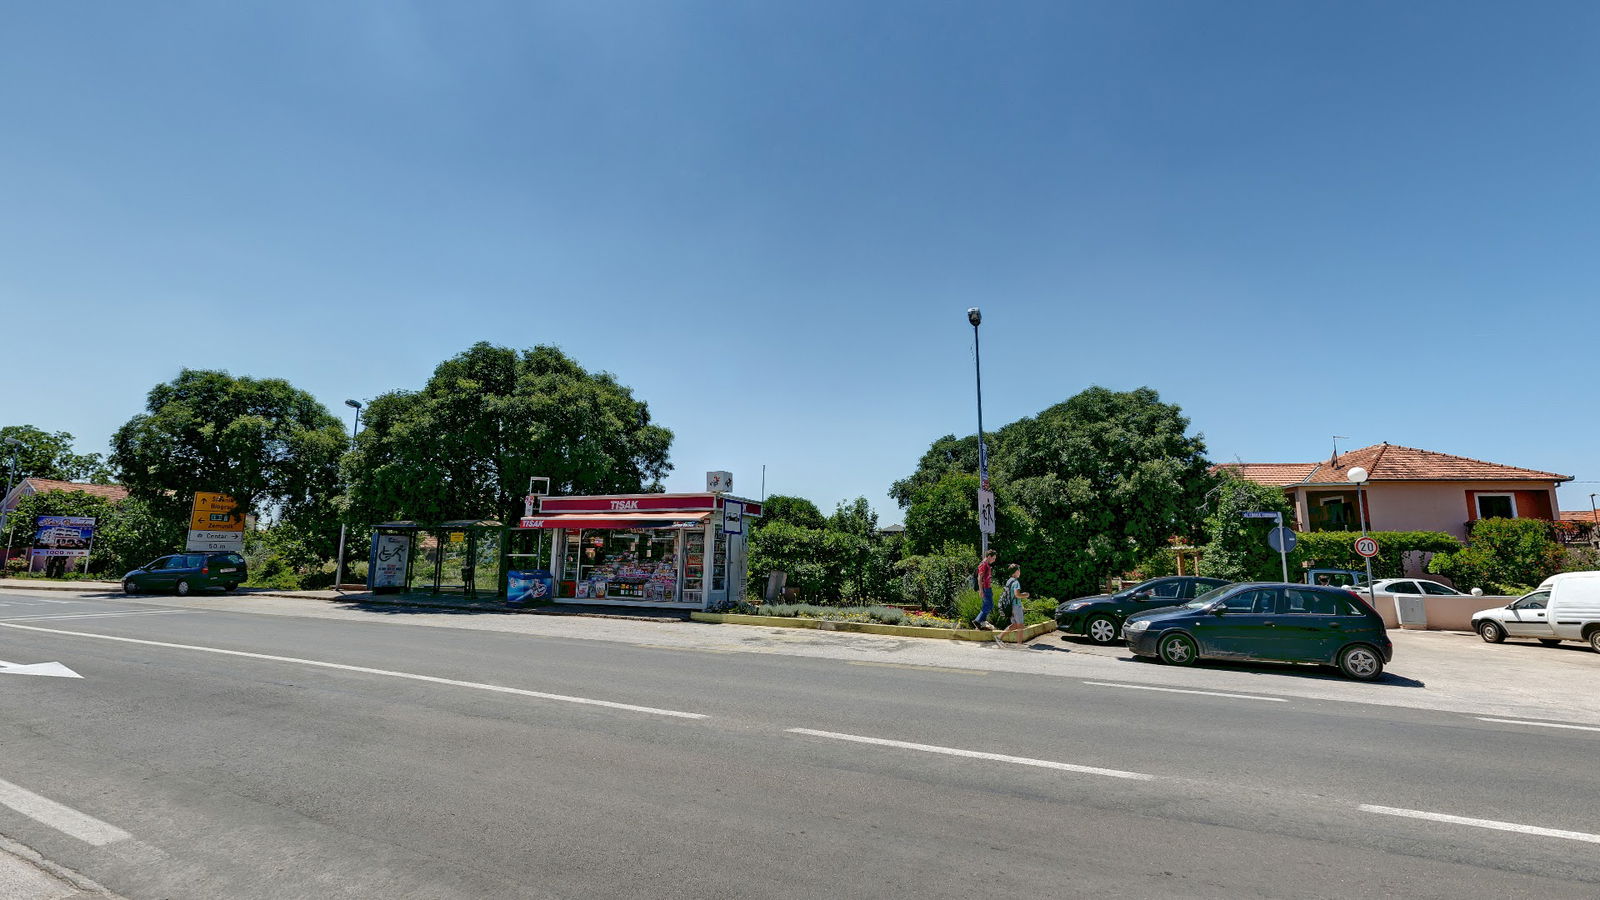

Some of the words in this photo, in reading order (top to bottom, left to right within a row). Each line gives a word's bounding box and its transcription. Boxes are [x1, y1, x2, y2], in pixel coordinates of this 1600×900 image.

[610, 500, 639, 510] TISAK
[522, 520, 545, 528] TISAK
[1359, 541, 1374, 552] 20
